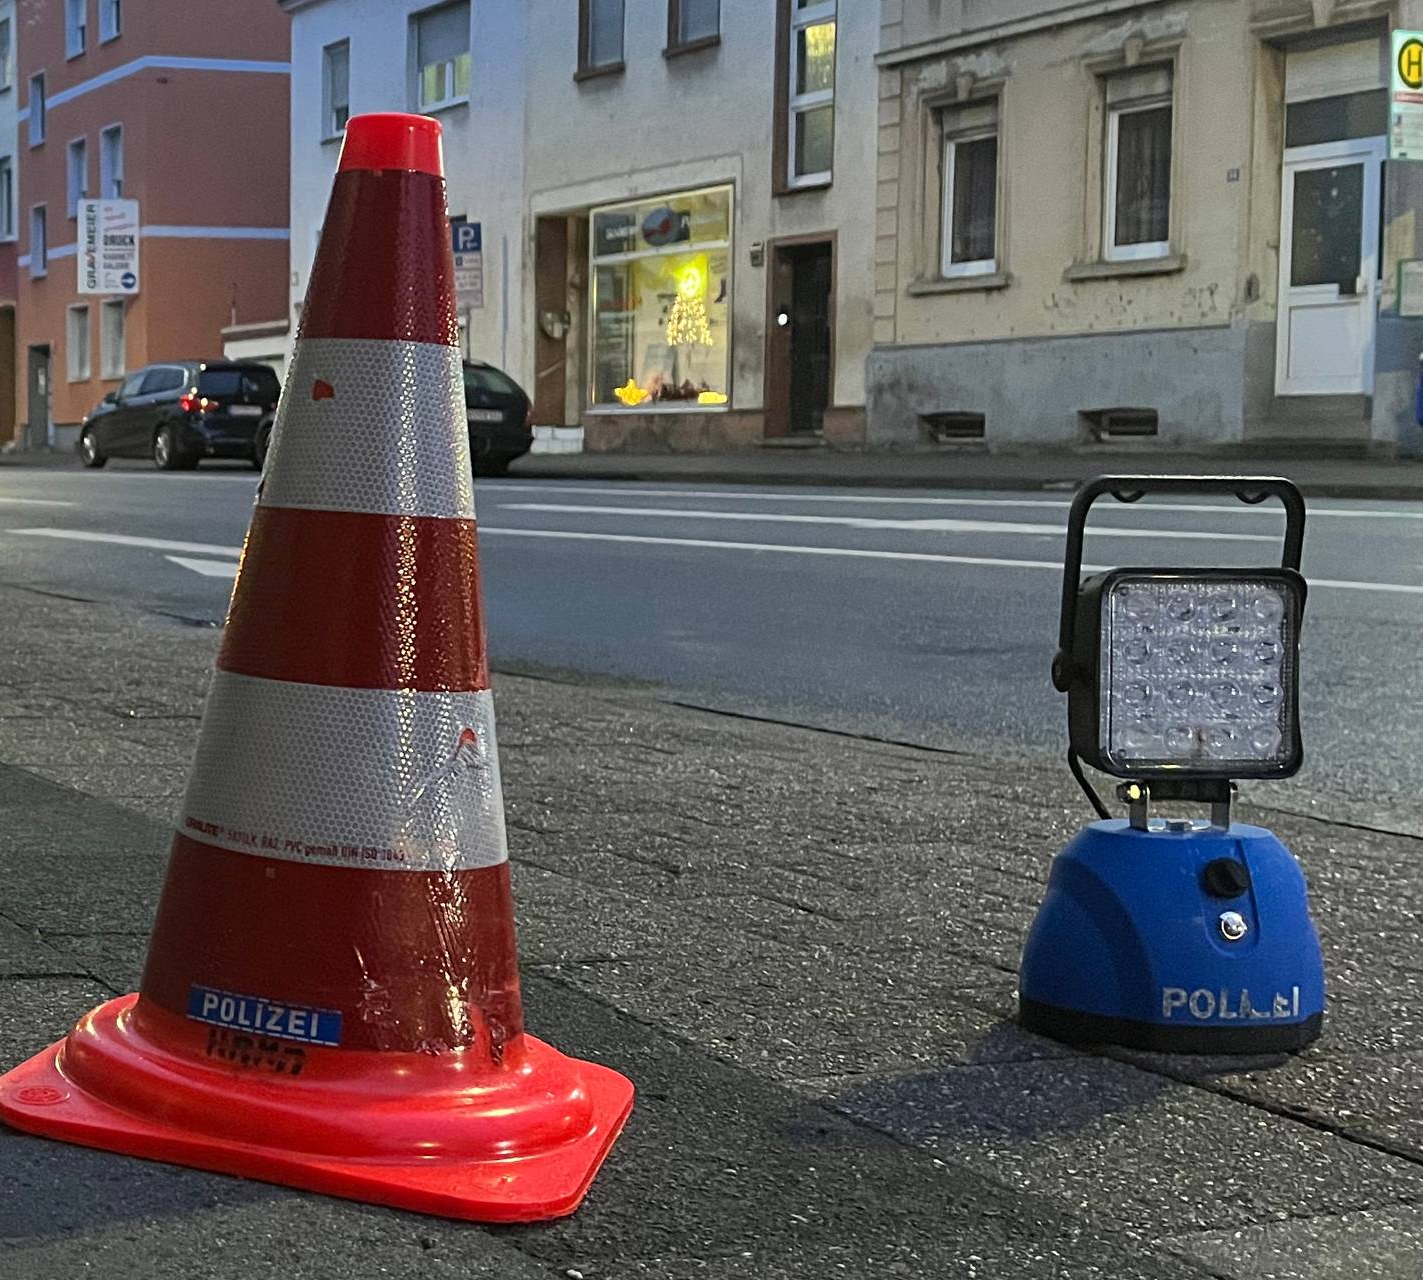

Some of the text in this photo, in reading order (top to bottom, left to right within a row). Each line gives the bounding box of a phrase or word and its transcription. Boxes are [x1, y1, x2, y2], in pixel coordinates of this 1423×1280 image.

[1407, 49, 1422, 77] H
[85, 204, 96, 289] GRAVEMEIER
[103, 234, 135, 246] DRUCK
[459, 226, 475, 250] P
[202, 992, 320, 1038] POLIZEI
